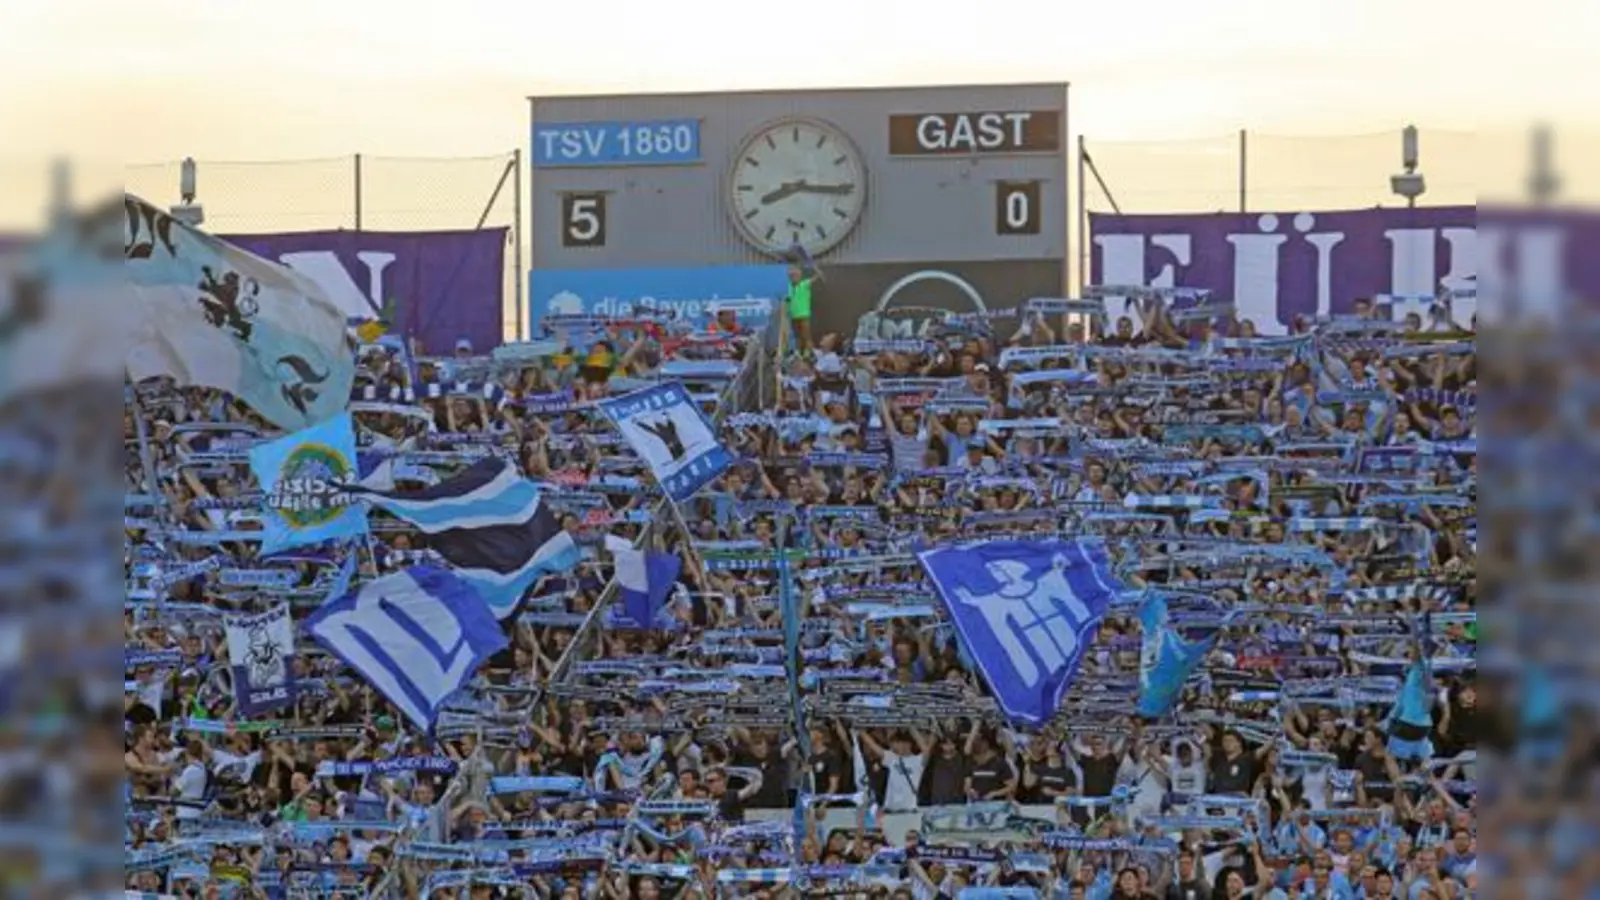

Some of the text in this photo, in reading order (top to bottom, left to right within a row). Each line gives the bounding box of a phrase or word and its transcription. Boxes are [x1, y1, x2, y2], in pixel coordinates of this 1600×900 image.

[539, 125, 692, 159] TSV 1860
[916, 112, 1031, 149] GAST
[569, 199, 600, 240] 5
[1006, 190, 1028, 228] 0
